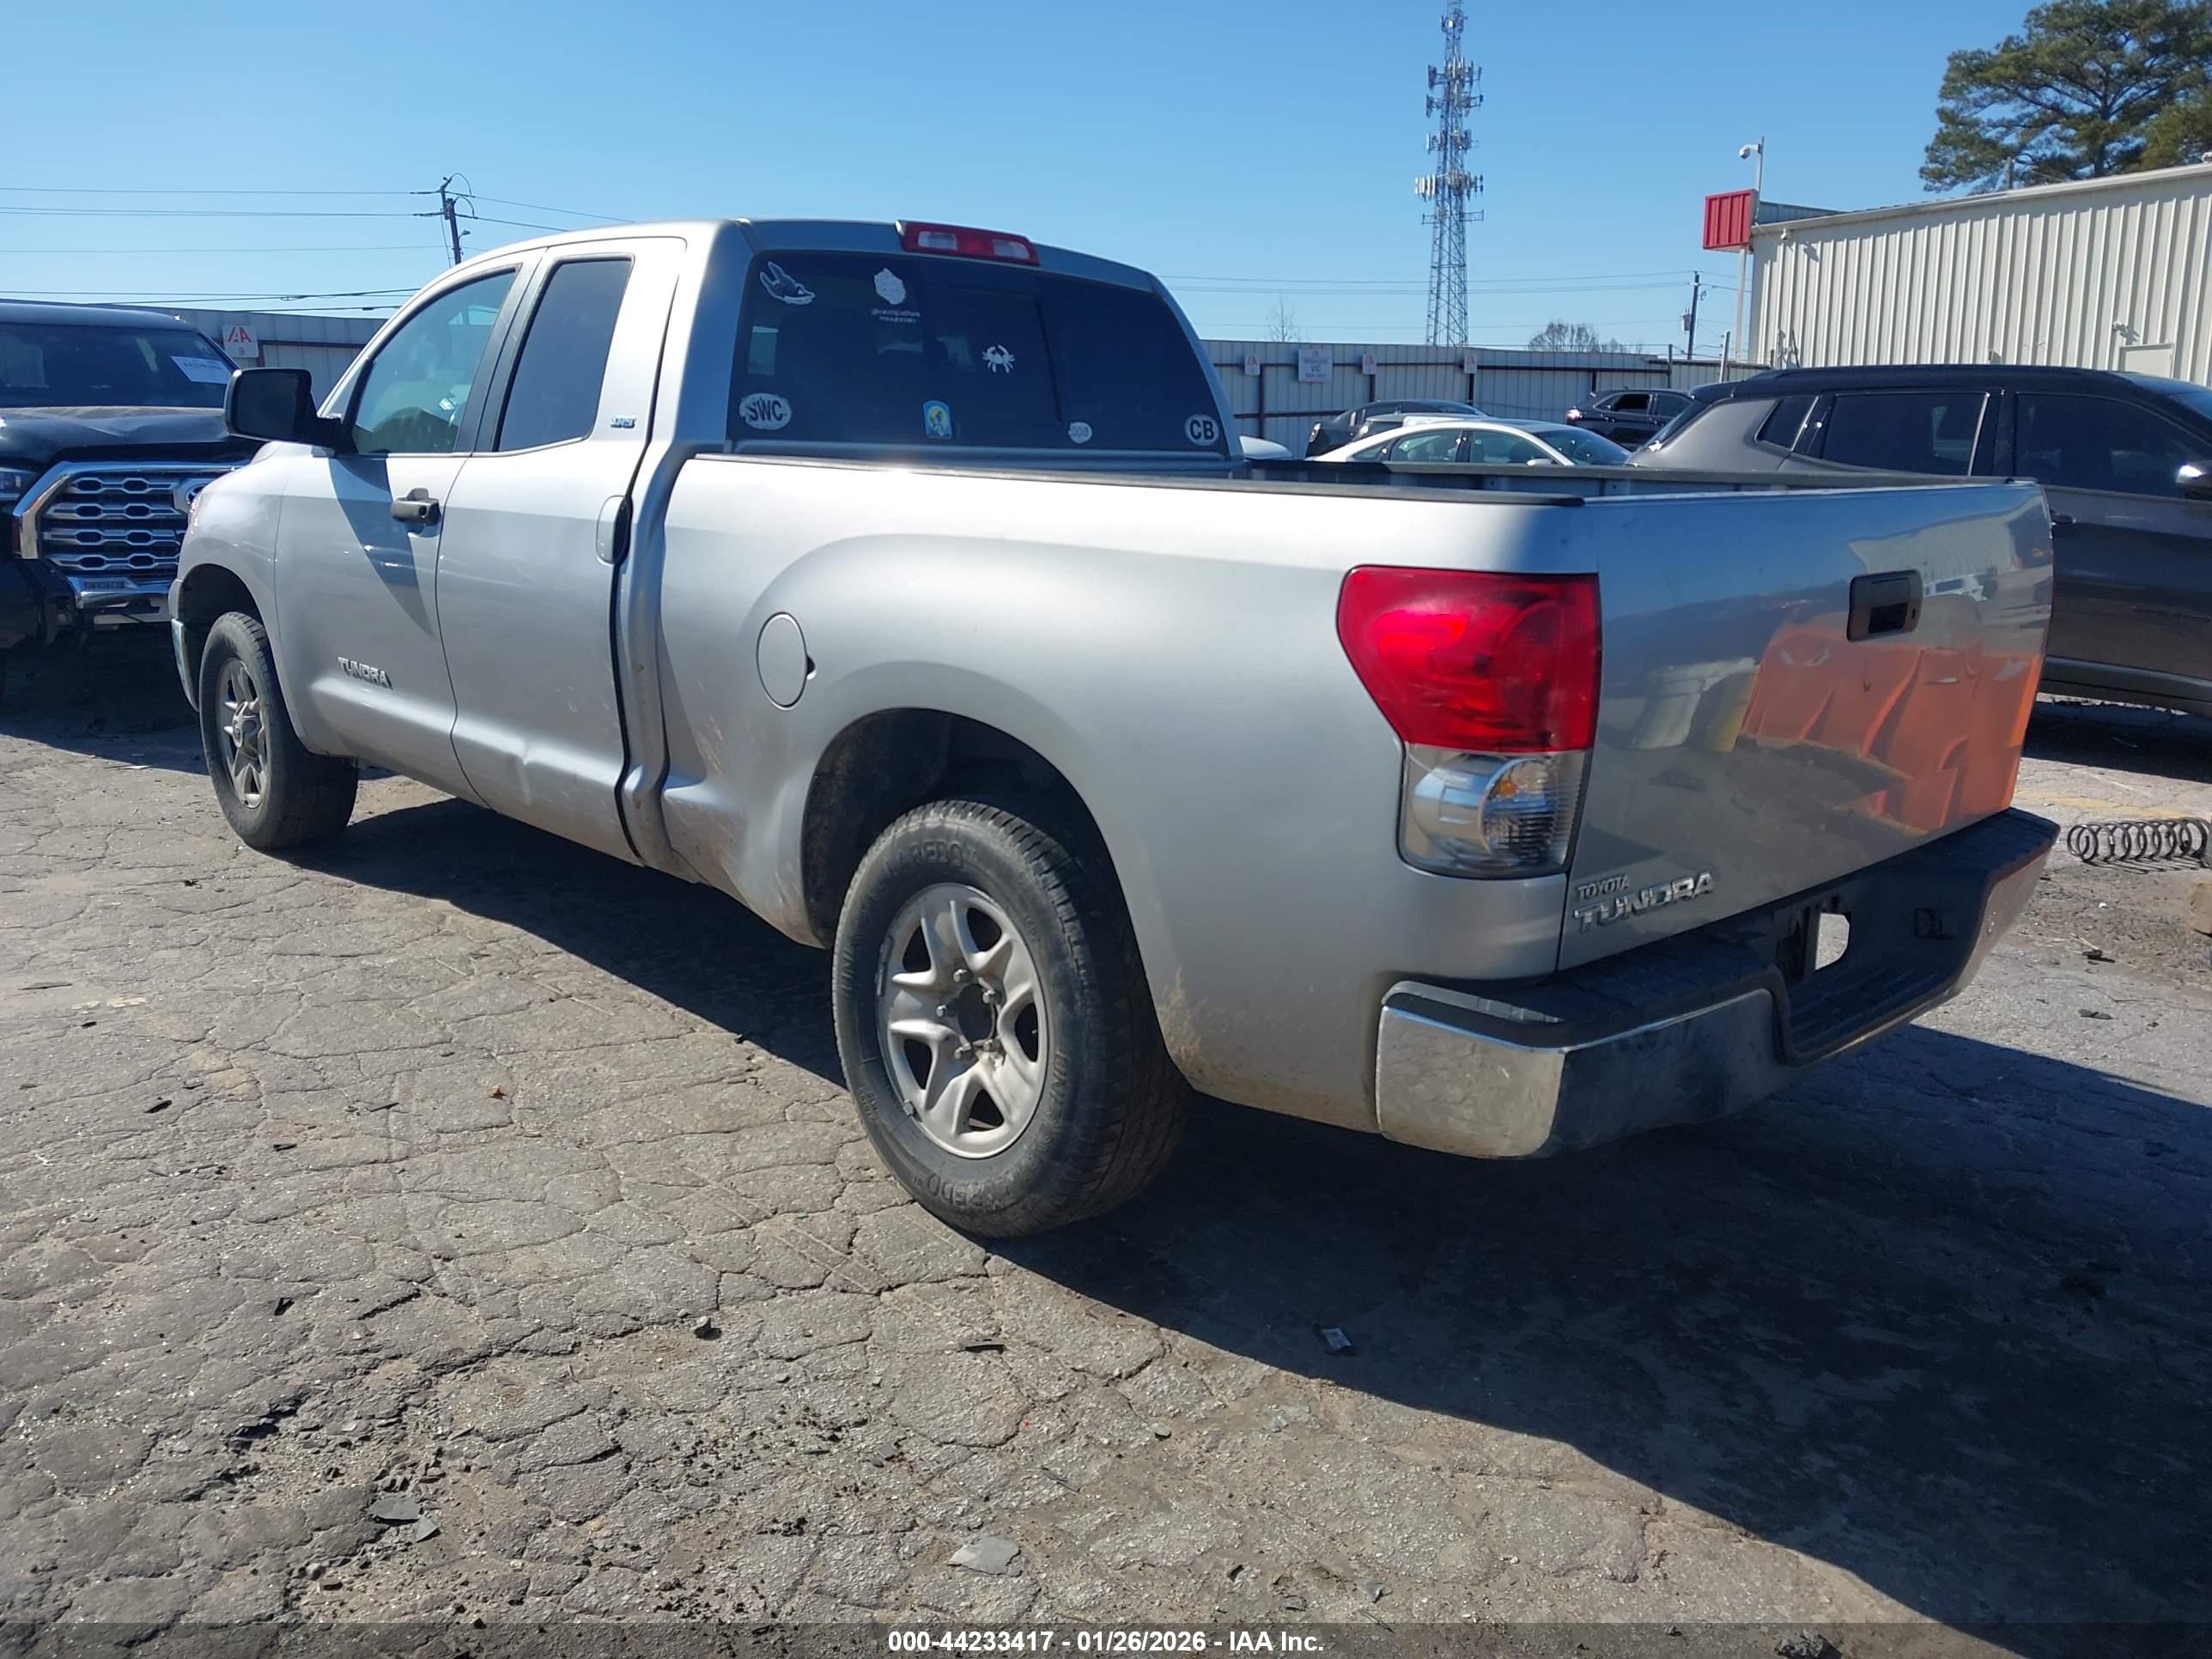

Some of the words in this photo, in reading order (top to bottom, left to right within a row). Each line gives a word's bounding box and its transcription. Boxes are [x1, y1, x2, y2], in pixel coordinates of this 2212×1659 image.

[745, 398, 783, 422] SWC
[1189, 420, 1214, 440] CB
[337, 656, 393, 690] TUNDRA
[1573, 871, 1714, 930] TUNDRA
[1577, 874, 1630, 901] TOYOTA
